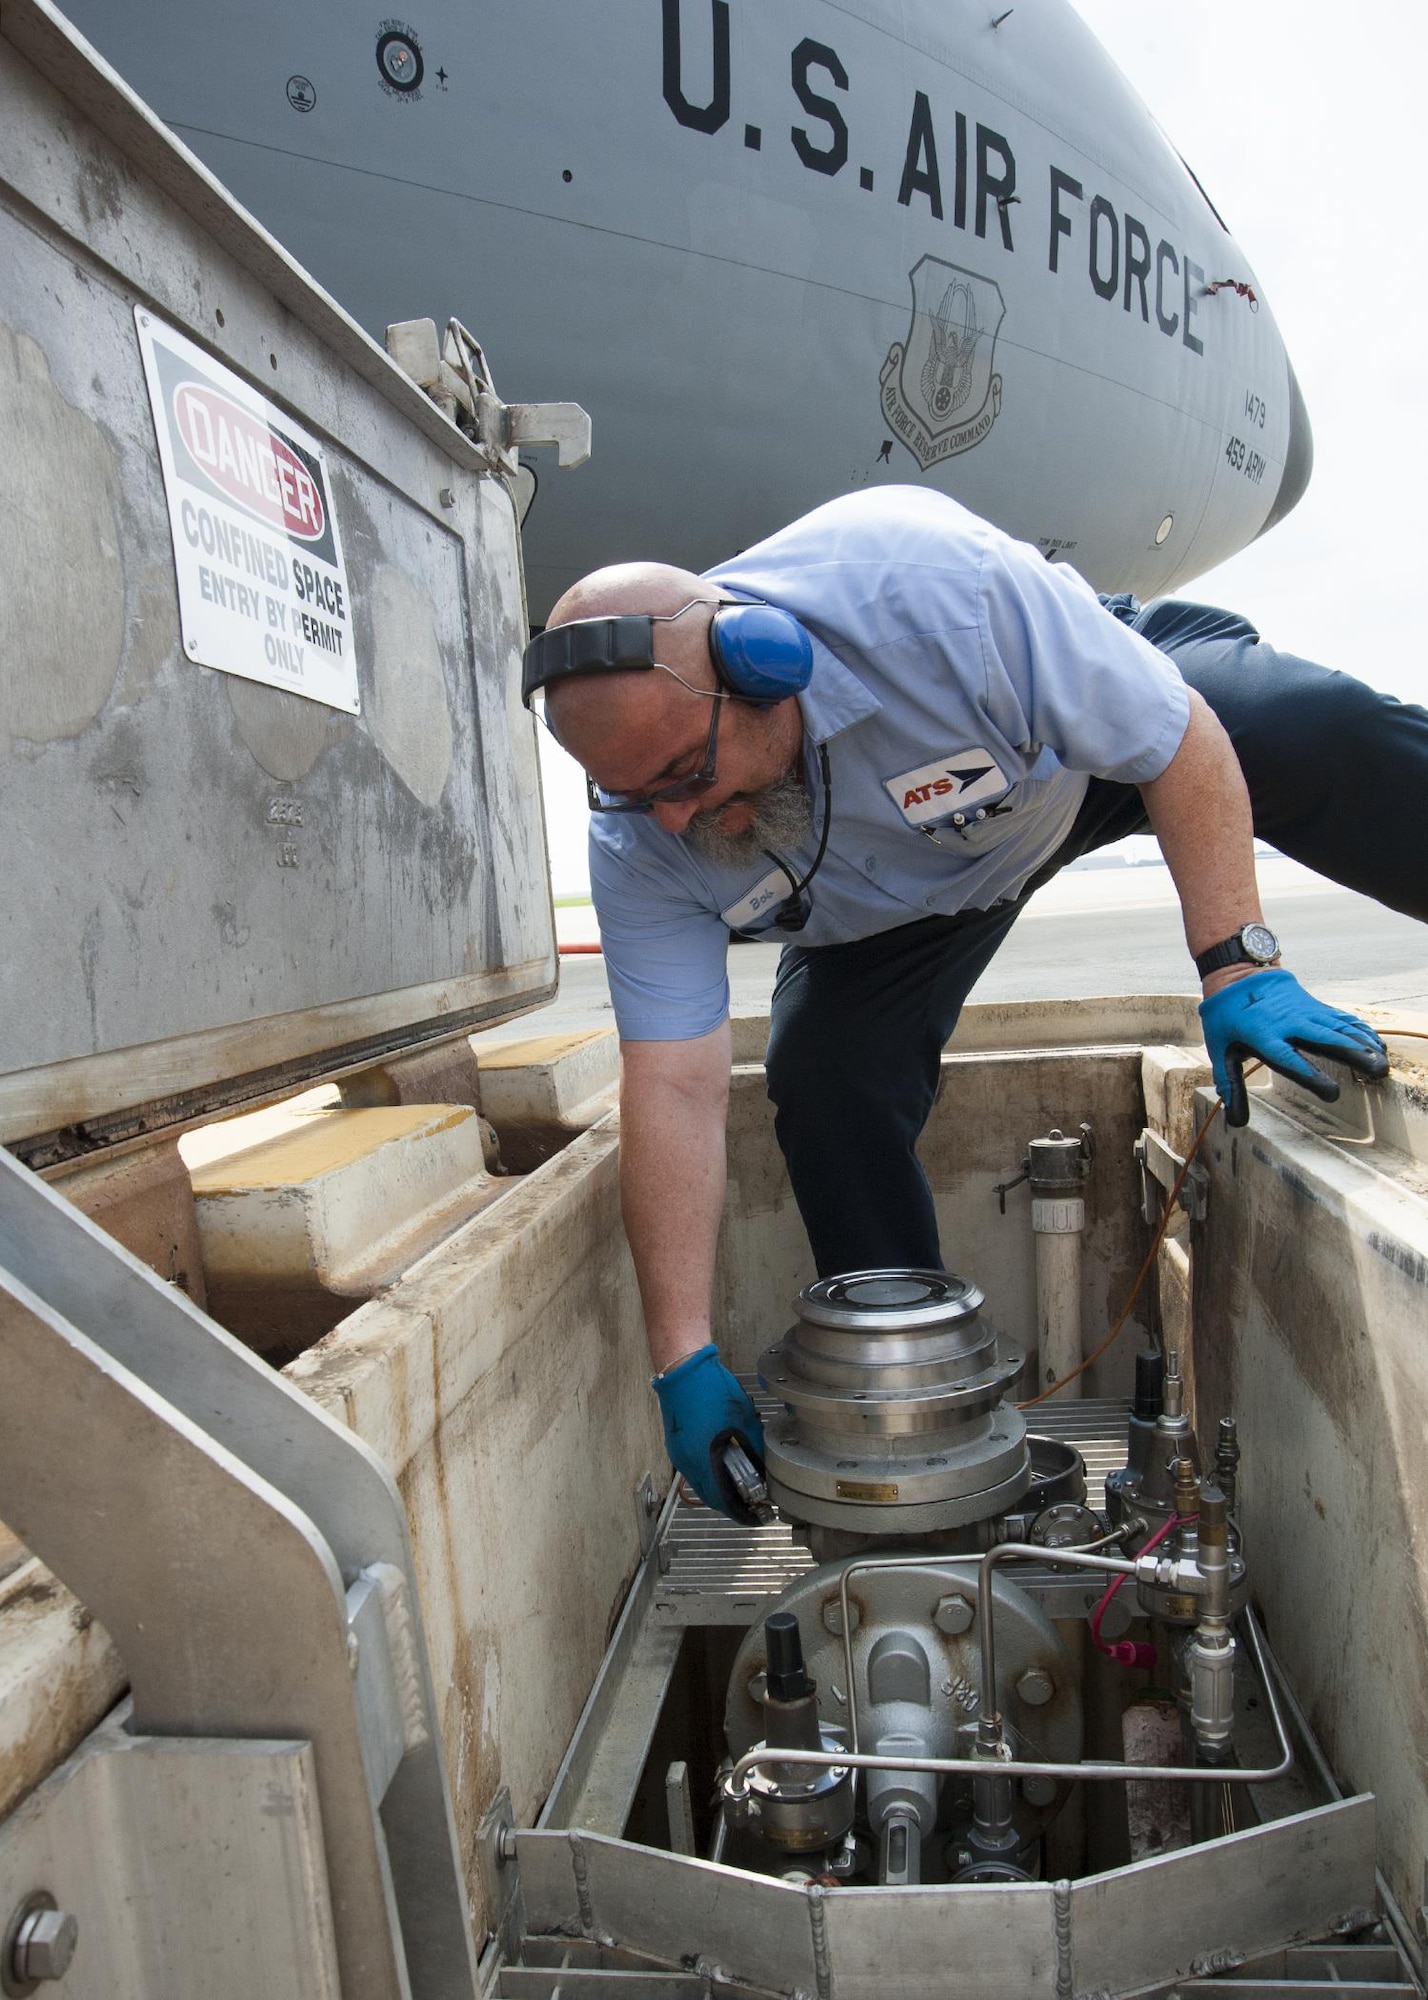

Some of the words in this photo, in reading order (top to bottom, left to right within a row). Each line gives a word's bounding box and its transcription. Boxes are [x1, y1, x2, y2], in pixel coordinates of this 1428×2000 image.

[662, 0, 874, 191] U.S.
[897, 90, 1016, 253] AIR
[1049, 164, 1205, 357] FORCE
[886, 387, 896, 412] AIR
[891, 406, 916, 438] FORCE
[913, 430, 947, 460] RESERVE
[950, 415, 990, 449] COMMAND
[1245, 389, 1266, 429] 1479
[184, 393, 320, 531] DANGER
[1225, 436, 1245, 471] 459
[1243, 450, 1267, 485] ARW
[181, 499, 290, 591] CONFINED
[292, 557, 346, 620] SPACE
[198, 565, 260, 622] ENTRY
[266, 597, 286, 632] BY
[292, 608, 343, 657] PERMIT
[264, 633, 306, 676] ONLY
[904, 778, 953, 809] ATS
